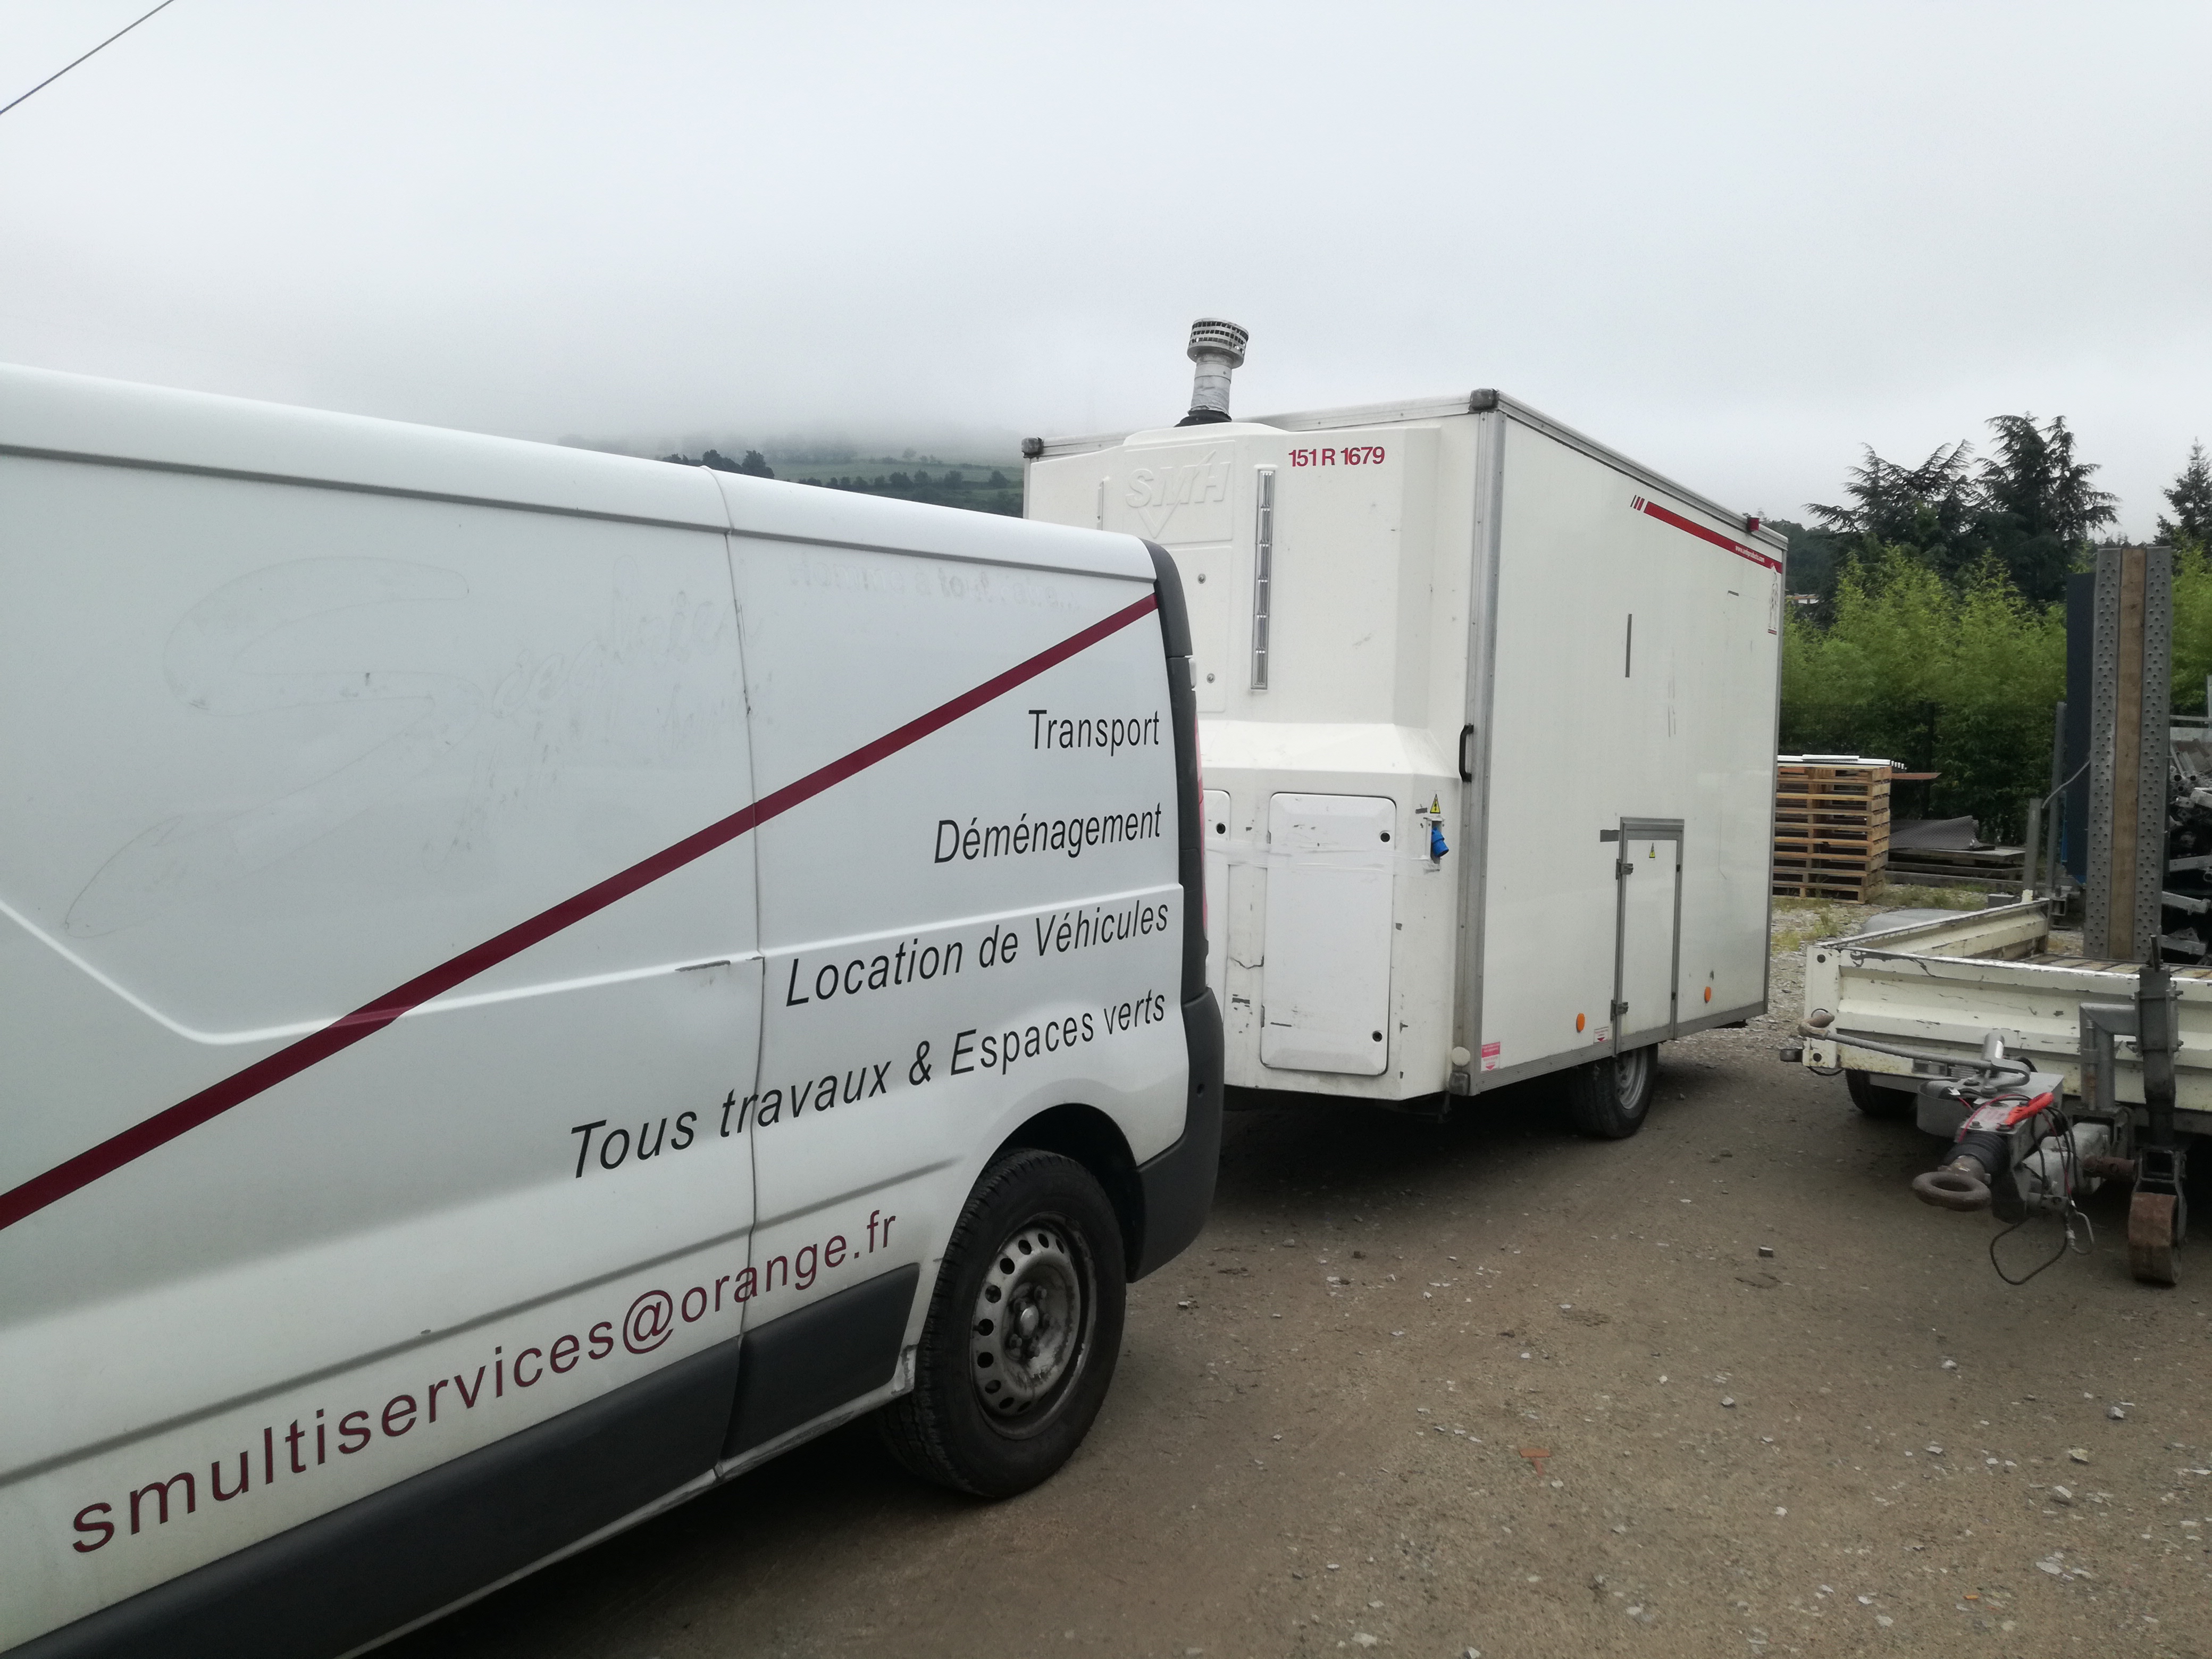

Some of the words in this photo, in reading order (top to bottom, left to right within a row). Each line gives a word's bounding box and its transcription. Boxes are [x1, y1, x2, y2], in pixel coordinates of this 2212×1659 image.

[1288, 449, 1317, 468] 151
[1321, 448, 1336, 467] R
[1341, 447, 1385, 466] 1679
[1028, 709, 1160, 757] Transport
[934, 802, 1162, 864] Déménagement
[786, 937, 963, 1007] Location
[979, 924, 1018, 968] de
[1035, 900, 1168, 957] Véhicules
[571, 1110, 698, 1179] Tous
[719, 1060, 892, 1138] travaux
[908, 1040, 933, 1086] &
[950, 1012, 1094, 1076] Espaces
[1103, 989, 1165, 1035] verts
[72, 1210, 896, 1553] smultiservices@orange.fr
